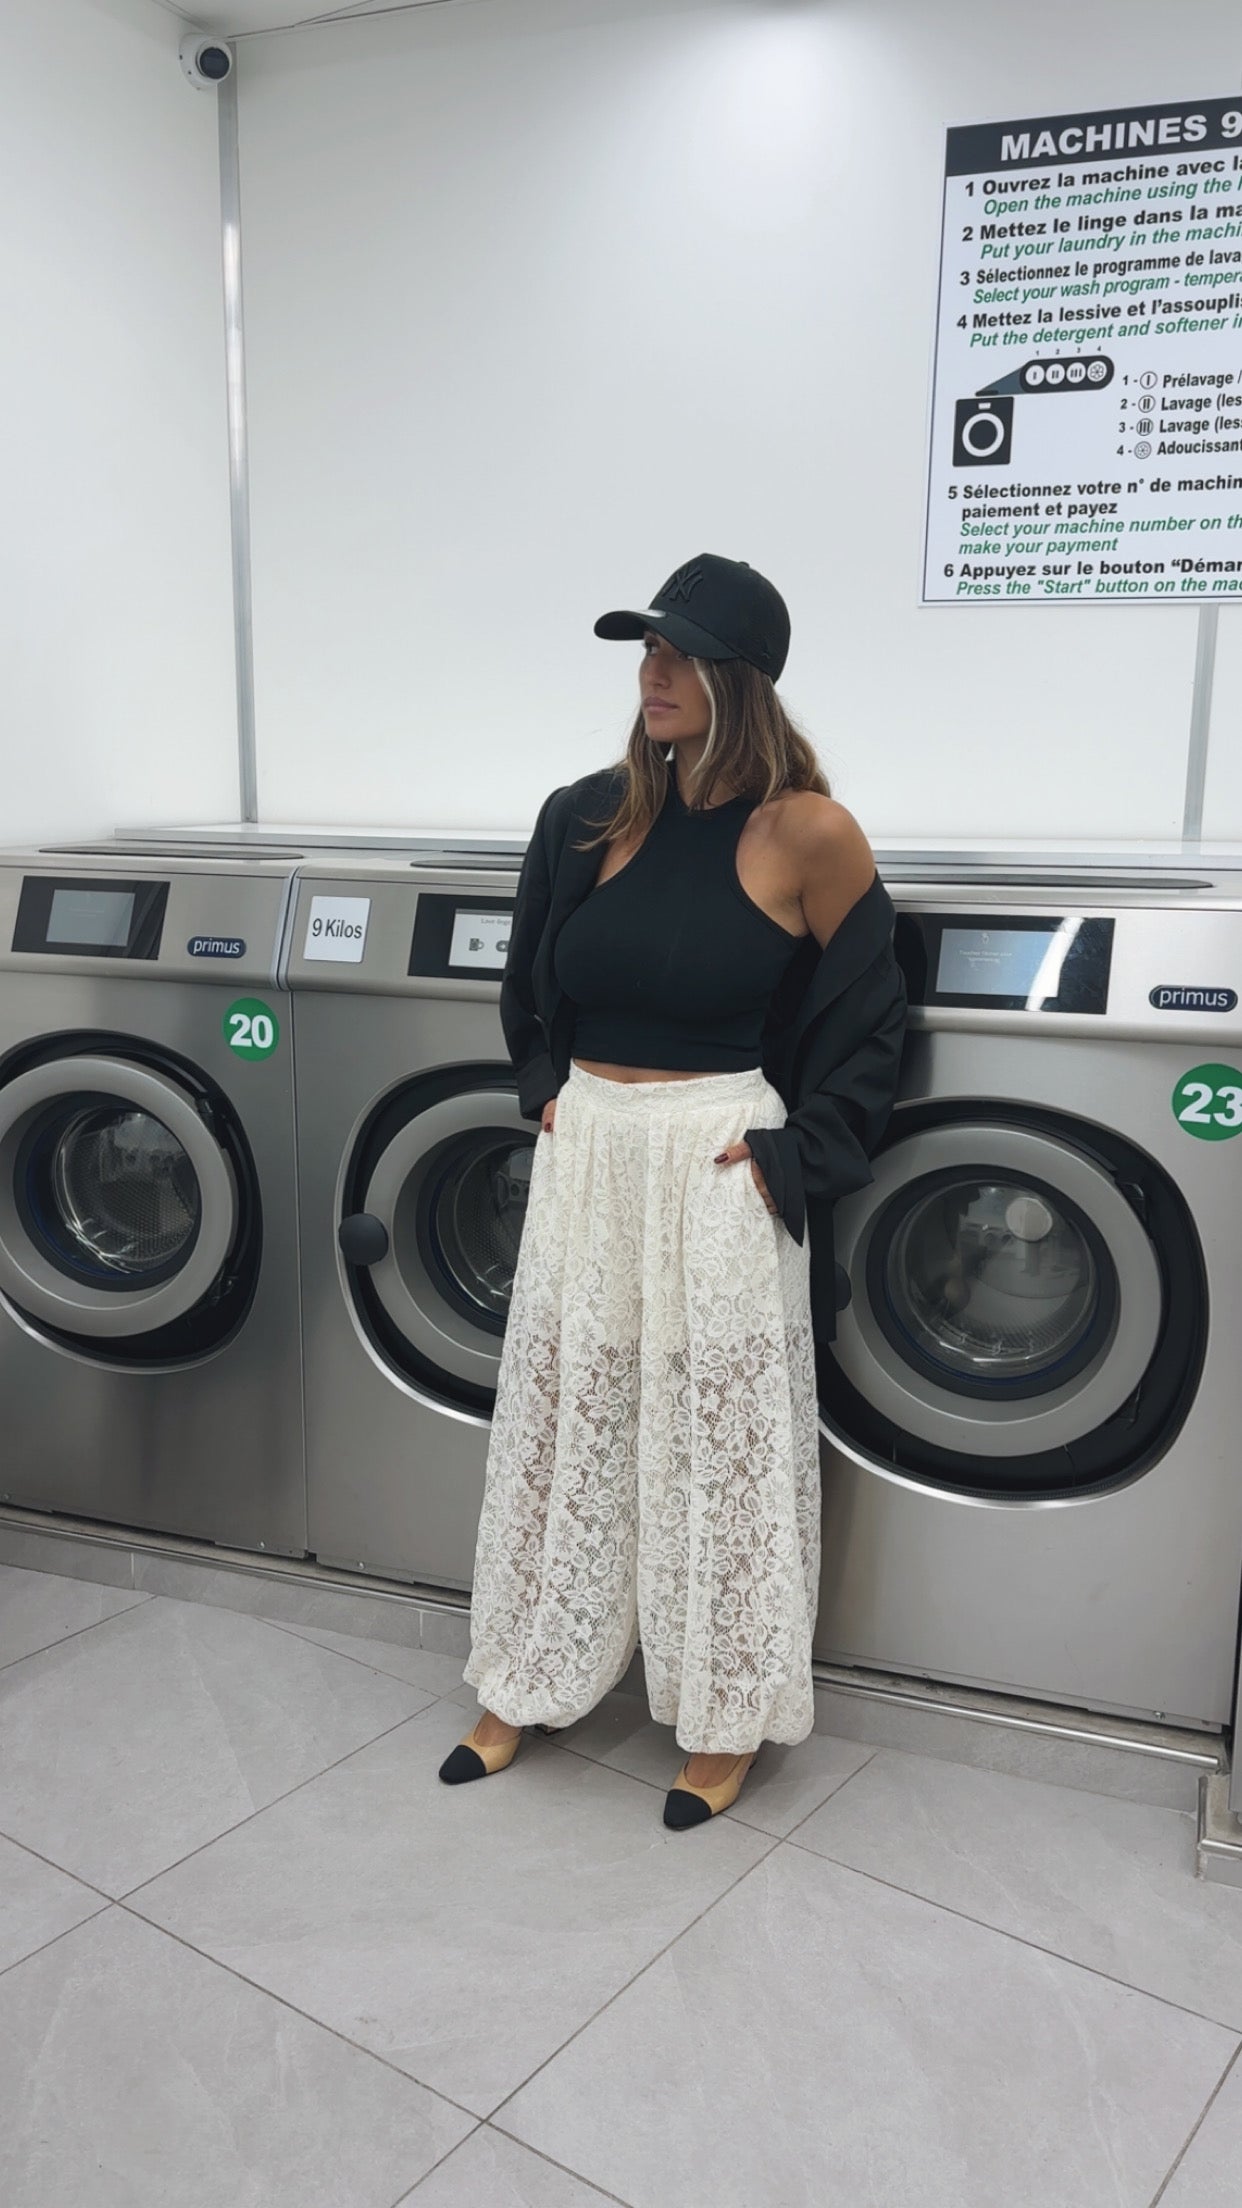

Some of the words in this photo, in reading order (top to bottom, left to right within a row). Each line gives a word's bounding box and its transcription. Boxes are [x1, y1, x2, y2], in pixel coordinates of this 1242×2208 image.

[1001, 115, 1207, 161] MACHINES
[965, 181, 974, 197] 1
[982, 177, 1051, 196] Ouvrez
[1057, 172, 1075, 188] la
[1081, 164, 1170, 186] machine
[1176, 160, 1225, 177] avec
[1232, 155, 1242, 171] l
[983, 199, 1029, 218] Open
[1034, 194, 1062, 210] the
[1065, 186, 1142, 207] machine
[1147, 181, 1198, 200] using
[1203, 177, 1232, 194] the
[962, 226, 974, 242] 2
[980, 221, 1047, 240] Mettez
[1053, 218, 1071, 234] le
[1077, 215, 1127, 233] linge
[1133, 209, 1183, 226] dans
[1189, 205, 1209, 221] la
[980, 243, 1010, 260] Put
[1012, 241, 1055, 261] your
[1058, 233, 1126, 253] laundry
[1129, 230, 1147, 246] in
[1152, 228, 1181, 244] the
[960, 270, 970, 286] 3
[976, 265, 1071, 285] Sélectionnez
[1074, 261, 1089, 277] le
[1092, 256, 1181, 279] programme
[1185, 251, 1205, 267] de
[1209, 249, 1242, 265] lava
[973, 287, 1020, 304] Select
[1021, 286, 1058, 304] your
[1060, 279, 1101, 297] wash
[1102, 277, 1170, 298] program
[956, 314, 968, 330] 4
[972, 312, 1032, 329] Mettez
[1037, 308, 1053, 324] la
[1059, 303, 1122, 322] lessive
[1127, 301, 1146, 317] et
[1151, 292, 1242, 317] l’assoupli
[970, 332, 999, 348] Put
[1002, 330, 1028, 346] the
[1032, 324, 1114, 344] detergent
[1117, 319, 1151, 337] and
[1154, 317, 1229, 335] softener
[1123, 375, 1129, 386] 1
[1162, 373, 1234, 389] Prélavage
[1120, 398, 1128, 410] 2
[1161, 397, 1212, 413] Lavage
[1119, 422, 1126, 433] 3
[1159, 419, 1210, 435] Lavage
[1214, 416, 1242, 434] (les
[1116, 445, 1124, 456] 4
[948, 485, 958, 500] 5
[963, 483, 1072, 499] Sélectionnez
[1077, 480, 1122, 495] votre
[1149, 477, 1172, 493] de
[962, 502, 1040, 522] paiement
[1045, 502, 1063, 516] et
[1067, 502, 1118, 519] payez
[960, 522, 1009, 537] Select
[1012, 523, 1051, 539] your
[1054, 518, 1125, 534] machine
[1129, 516, 1196, 532] number
[1200, 518, 1222, 530] on
[958, 540, 1001, 554] make
[1004, 542, 1043, 557] your
[1045, 538, 1118, 556] payment
[944, 563, 954, 578] 6
[959, 563, 1036, 580] Appuyez
[1042, 564, 1072, 576] sur
[1077, 561, 1094, 575] le
[1099, 560, 1165, 575] bouton
[956, 581, 1001, 595] Press
[1006, 580, 1031, 595] the
[1038, 579, 1091, 594] "Start"
[1095, 579, 1149, 593] button
[1154, 581, 1176, 592] on
[1181, 577, 1207, 592] the
[311, 918, 323, 937] 9
[325, 919, 363, 939] Kilos
[193, 938, 241, 955] primus
[1159, 987, 1229, 1008] primus
[229, 1013, 274, 1049] 20
[1178, 1082, 1242, 1127] 23
